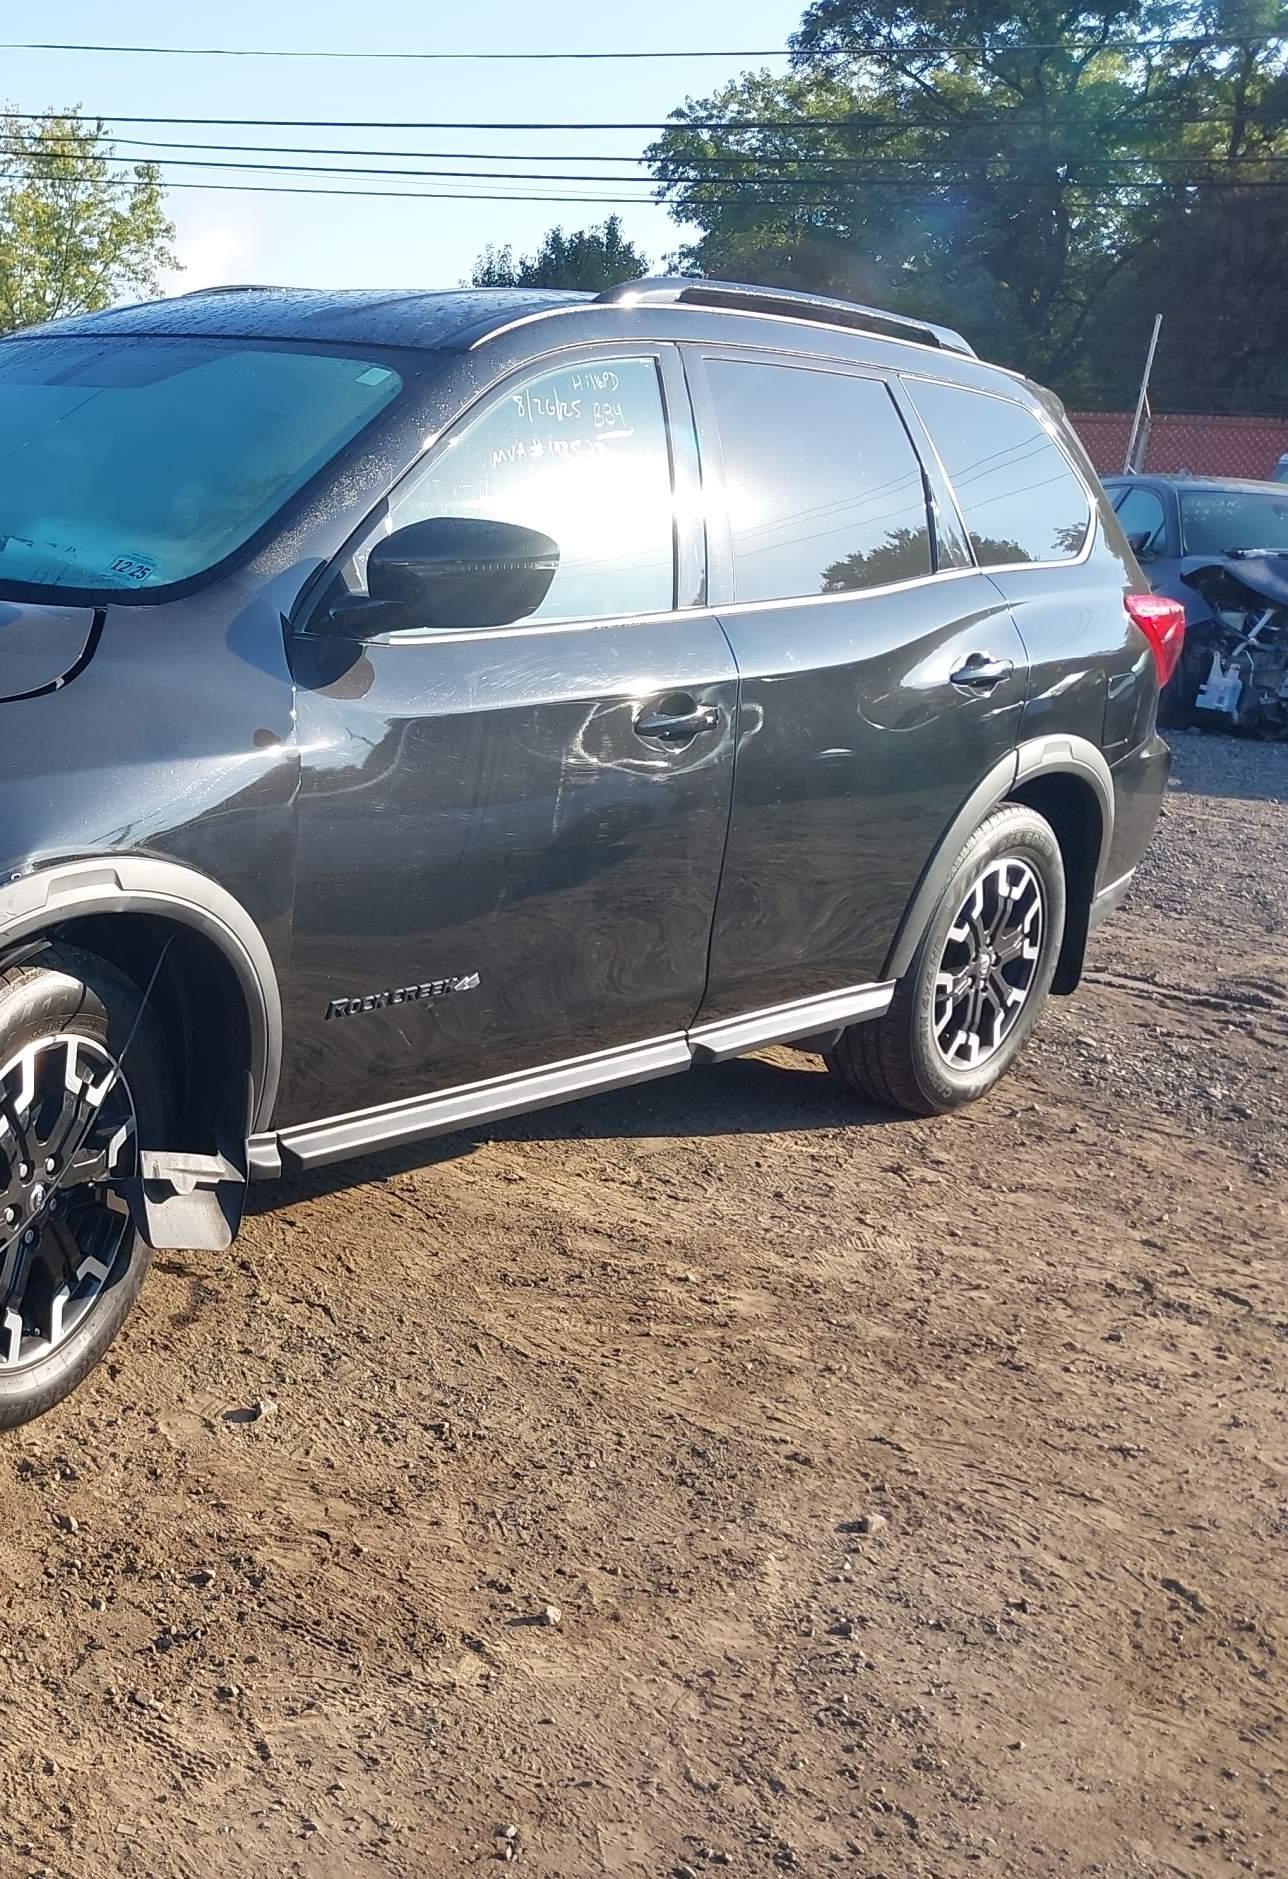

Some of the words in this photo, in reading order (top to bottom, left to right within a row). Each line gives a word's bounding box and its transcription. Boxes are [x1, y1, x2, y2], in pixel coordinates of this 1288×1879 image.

[511, 388, 582, 423] 8/26/25
[110, 559, 132, 573] 12
[128, 565, 151, 580] 25
[324, 992, 389, 1020] ROCK
[392, 977, 460, 1004] CREEK
